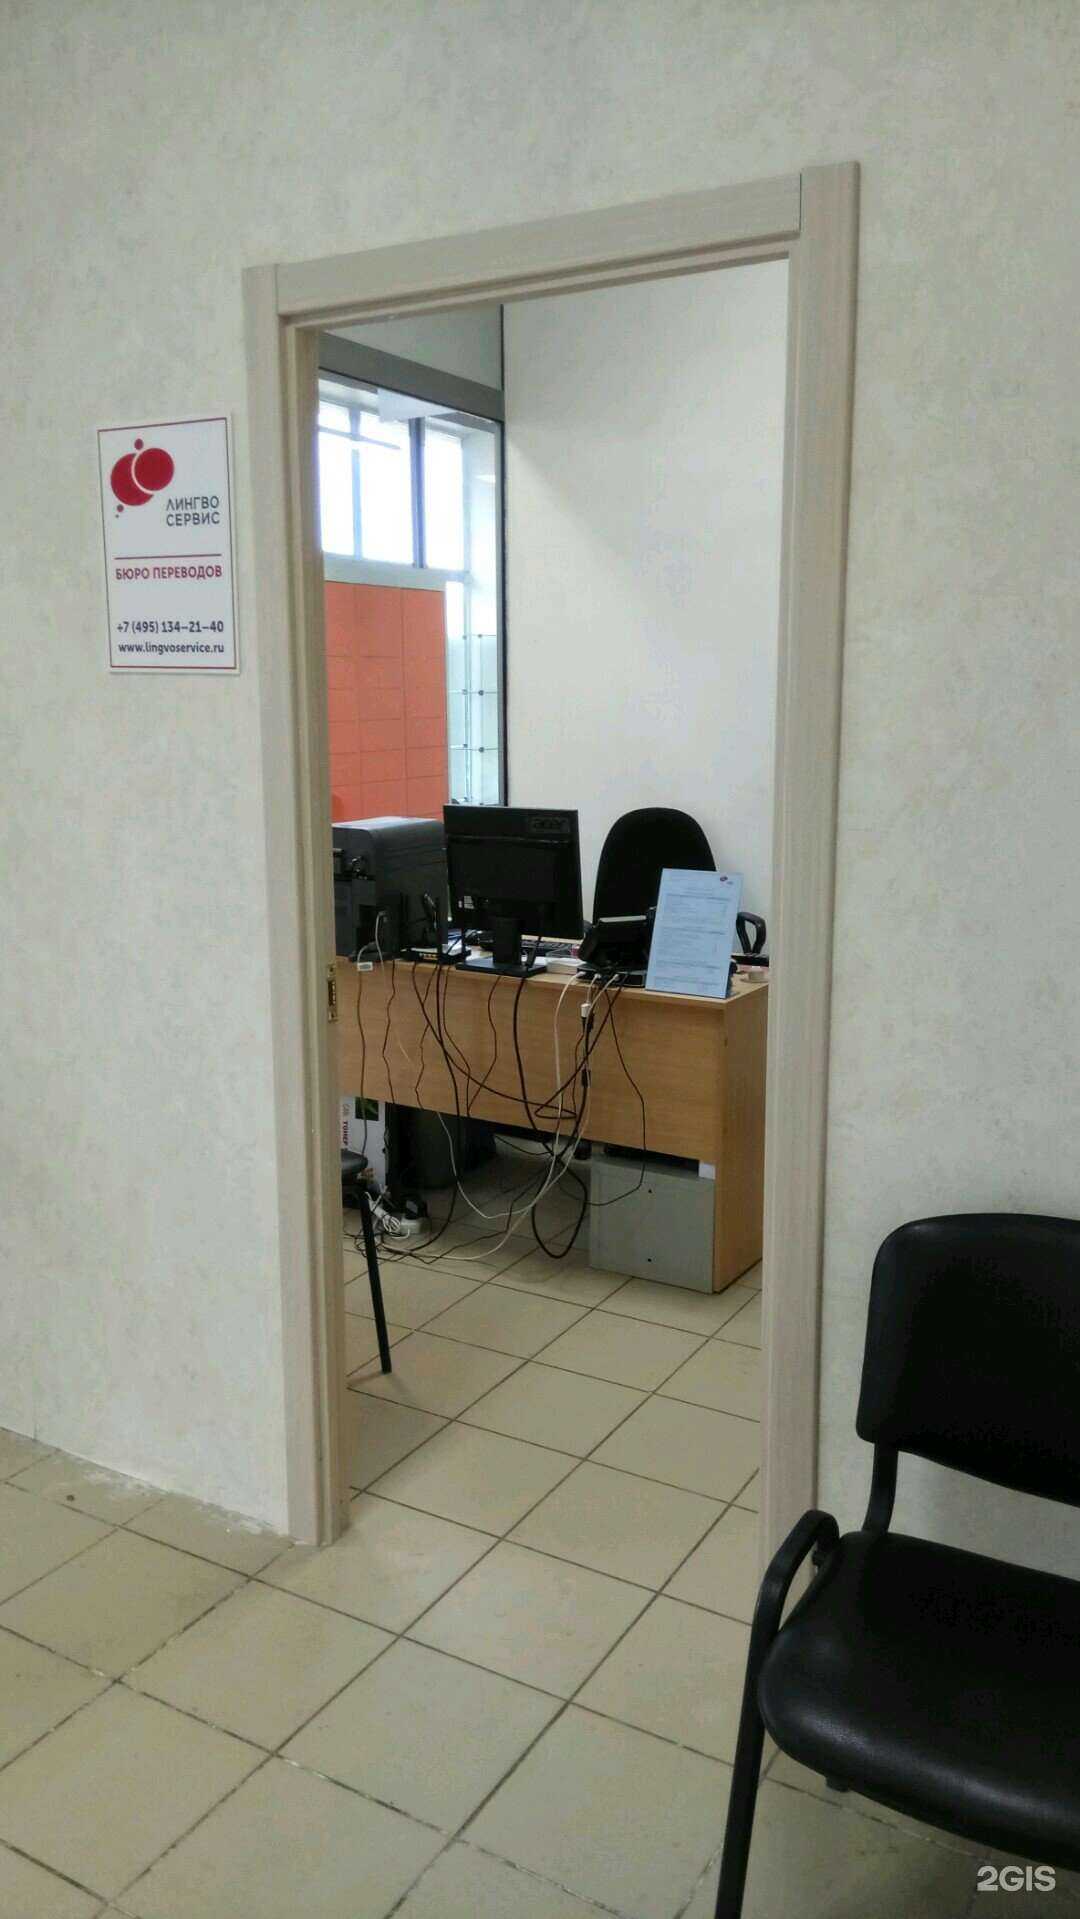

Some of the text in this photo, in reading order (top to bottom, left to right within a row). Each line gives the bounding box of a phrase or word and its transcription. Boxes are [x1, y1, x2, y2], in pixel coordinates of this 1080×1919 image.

[166, 496, 219, 511] ЛИНГВО
[166, 512, 220, 527] СЕРВИС
[116, 565, 223, 581] БЮРО ПЕРЕВОДОВ
[117, 622, 130, 633] +7
[131, 621, 159, 635] (495)
[118, 641, 224, 656] www.lingvoservice.ru
